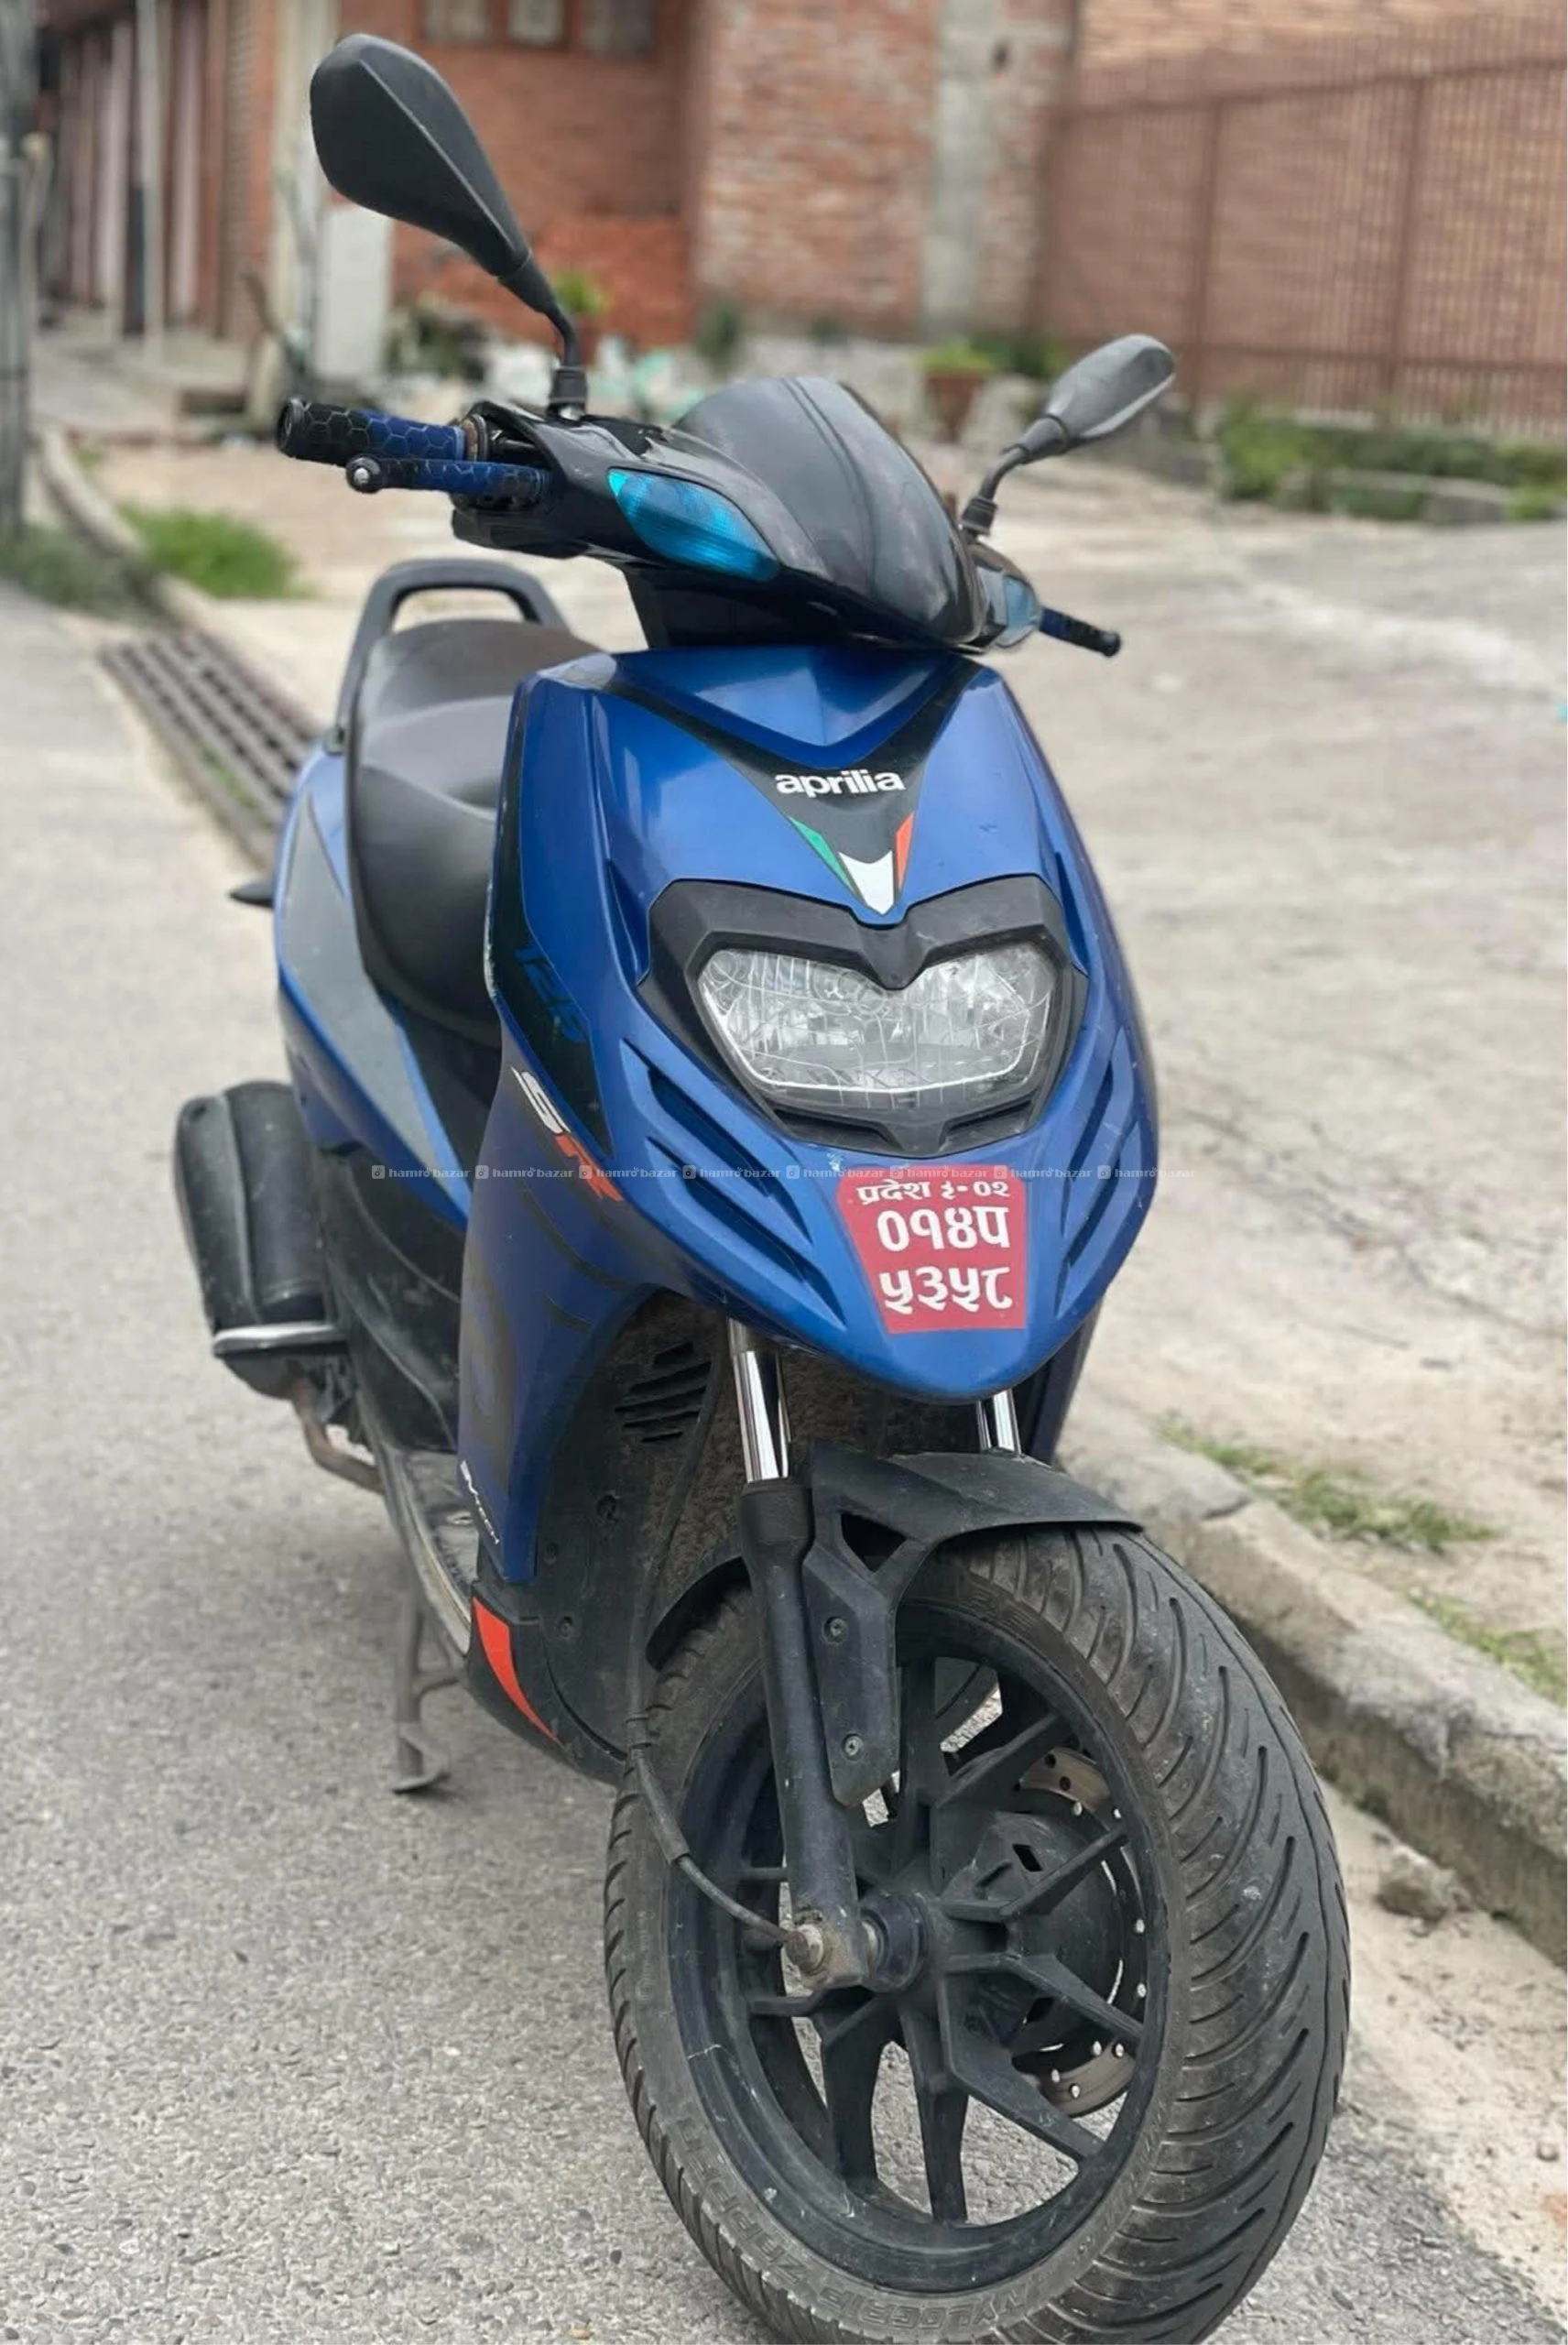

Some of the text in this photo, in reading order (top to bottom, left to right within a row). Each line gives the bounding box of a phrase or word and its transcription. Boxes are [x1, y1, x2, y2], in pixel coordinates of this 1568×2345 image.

[775, 769, 906, 798] aprilia
[855, 1179, 932, 1205] प्रदेश
[877, 1205, 1010, 1251] ०१४प
[878, 1266, 1013, 1314] ५३५८
